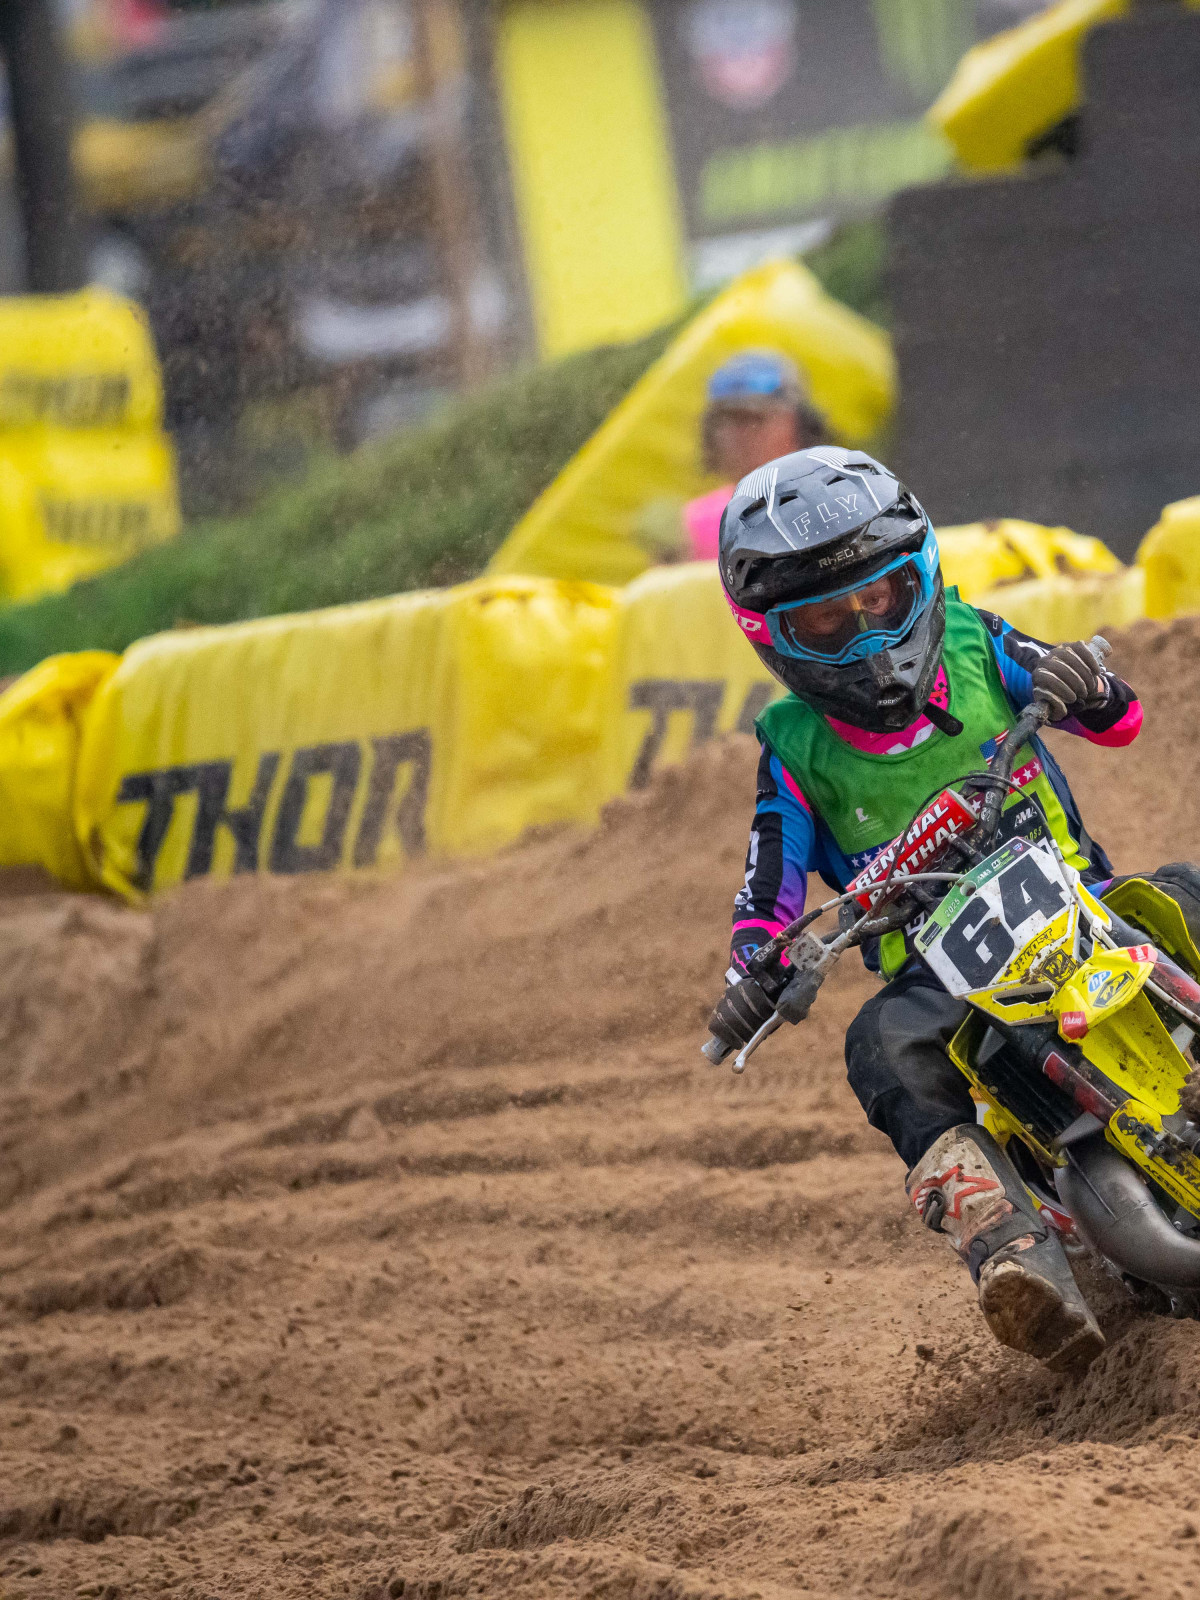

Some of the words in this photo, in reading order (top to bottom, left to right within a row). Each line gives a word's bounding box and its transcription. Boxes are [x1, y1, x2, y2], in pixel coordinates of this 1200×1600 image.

[792, 493, 859, 537] FLY
[116, 725, 433, 893] THOR
[854, 802, 950, 891] RENTHAL
[940, 853, 1067, 990] 64
[943, 897, 962, 918] 2025
